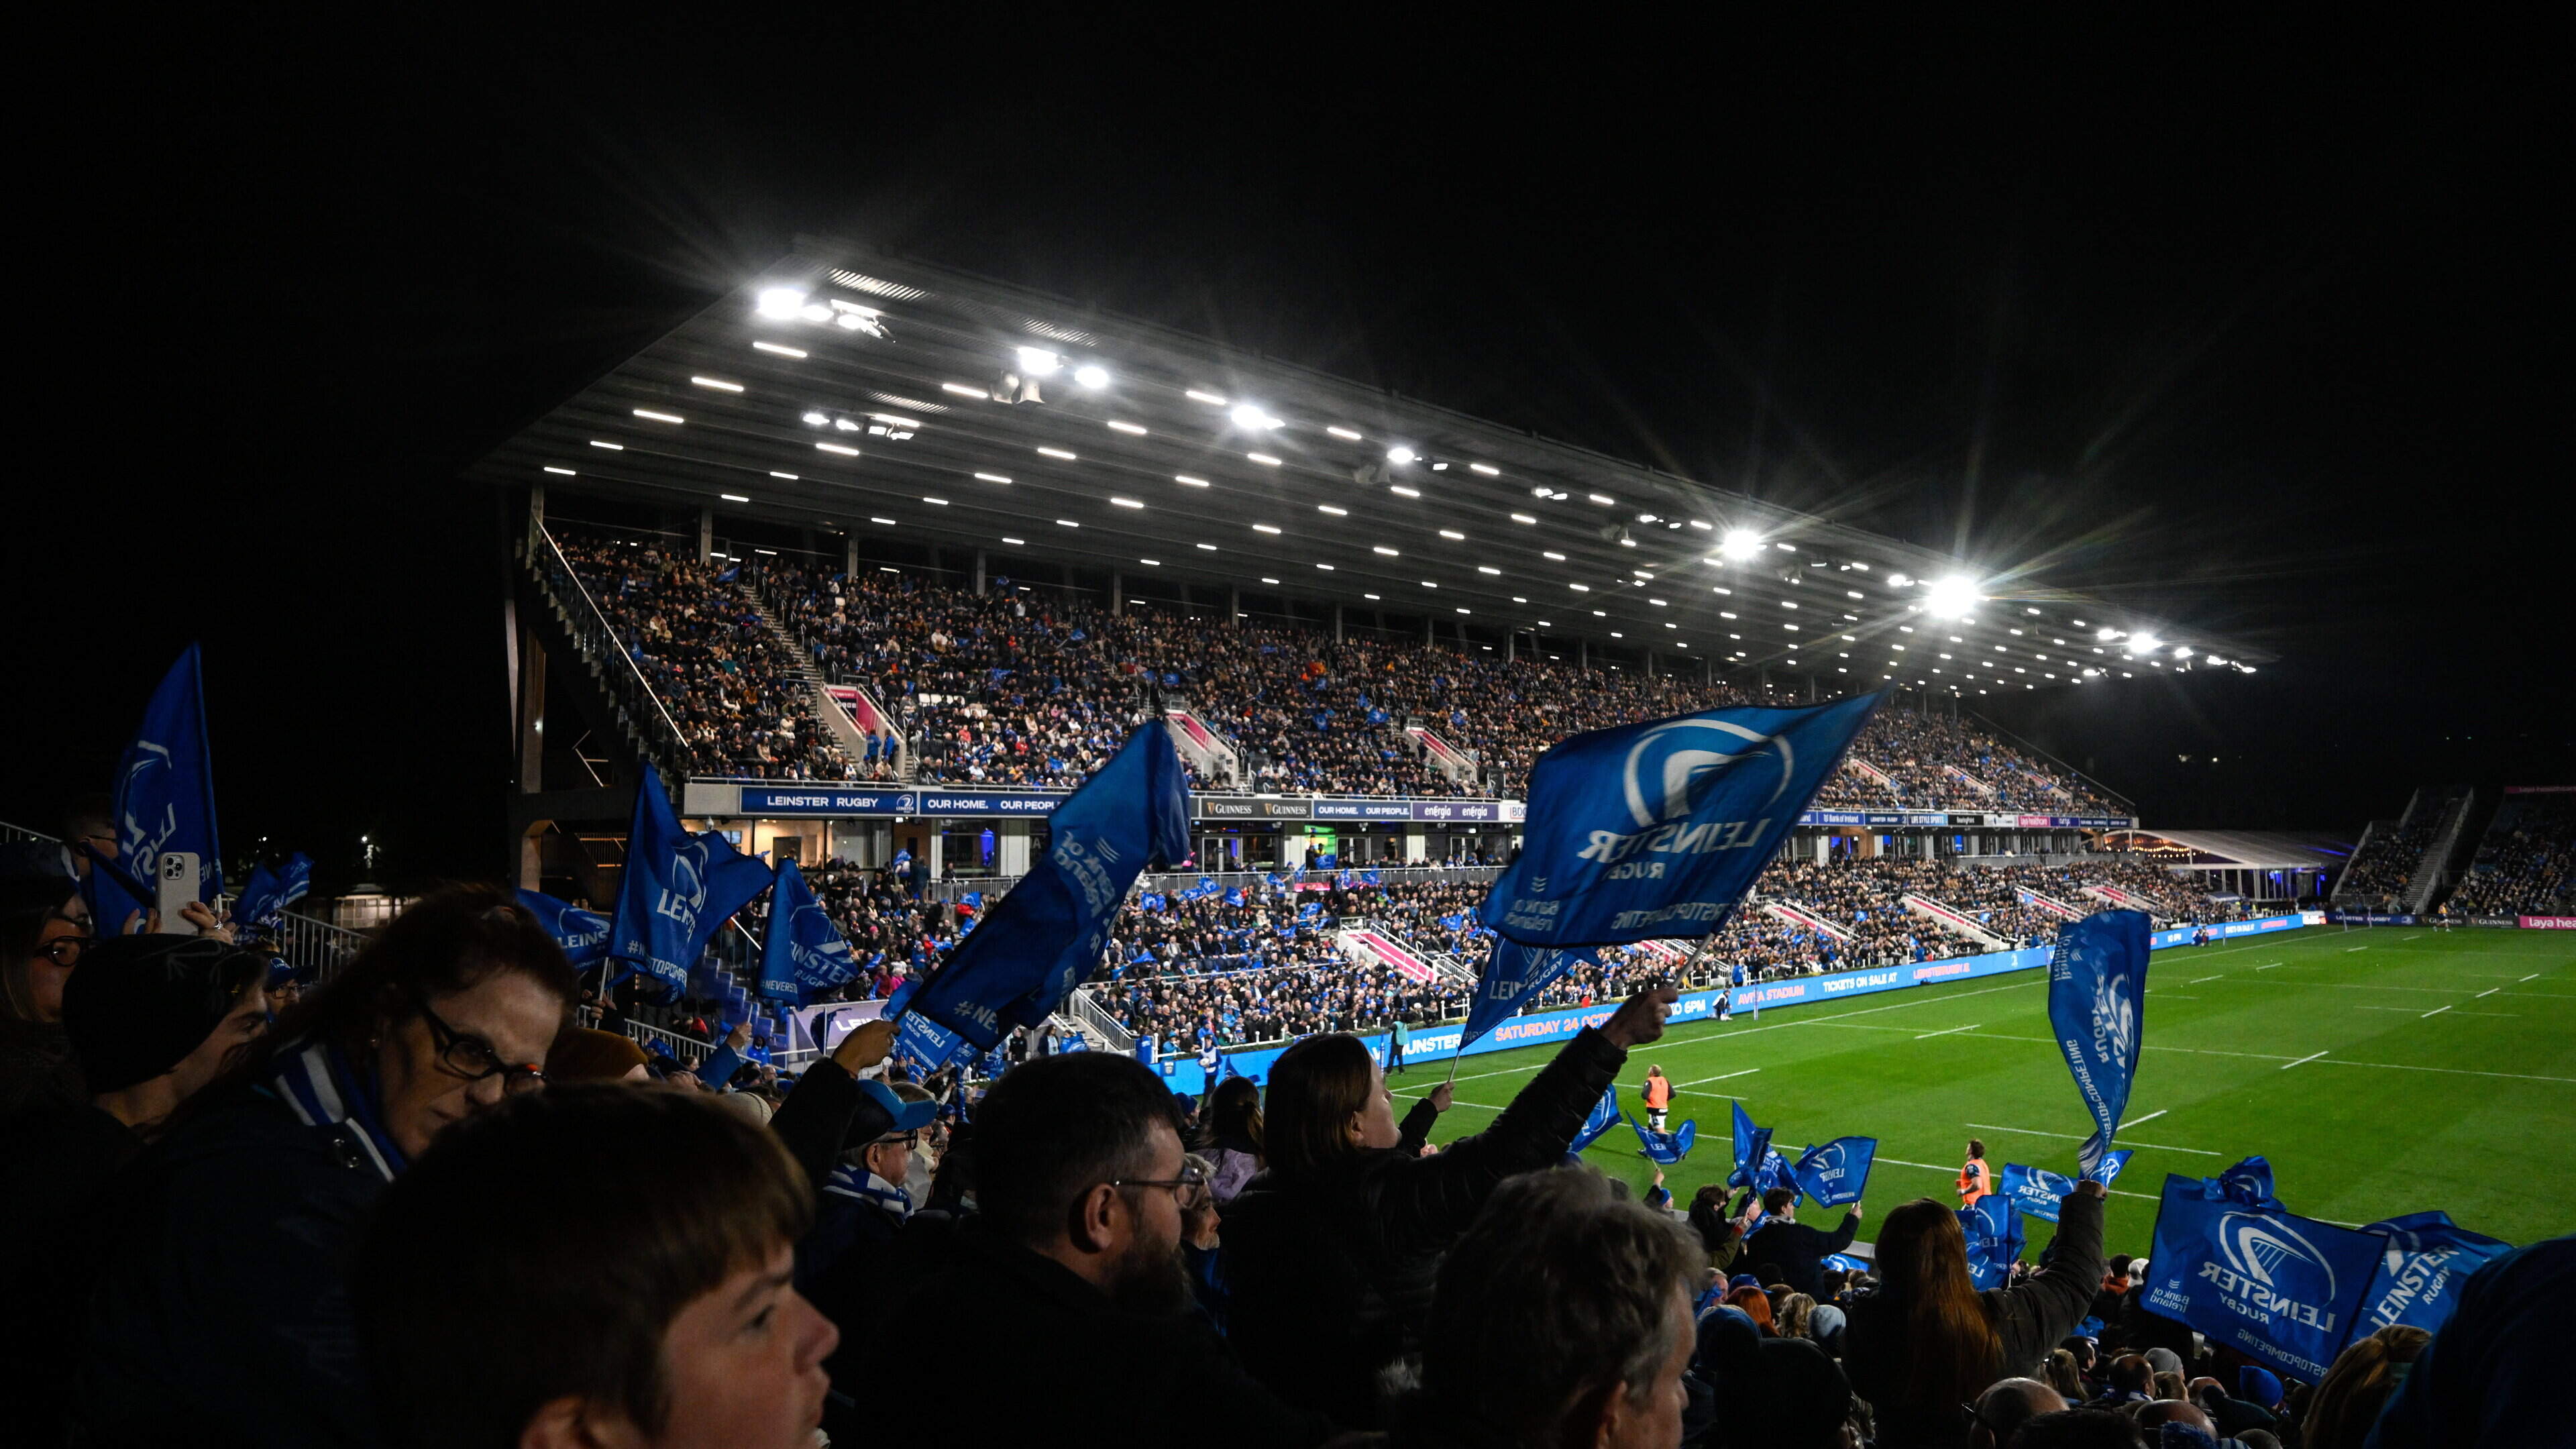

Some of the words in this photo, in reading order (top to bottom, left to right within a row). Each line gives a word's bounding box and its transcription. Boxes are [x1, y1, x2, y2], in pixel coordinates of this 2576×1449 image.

[767, 796, 829, 807] LEINSTER
[837, 797, 879, 808] RUGBY
[927, 799, 953, 809] OUR
[953, 800, 989, 809] HOME.
[1000, 800, 1022, 810] OUR
[1215, 804, 1252, 814] GUINNESS
[1272, 804, 1307, 815] GUINNESS
[1318, 806, 1334, 814] OUR
[1335, 806, 1358, 814] HOME.
[1366, 807, 1381, 815] OUR
[1381, 808, 1409, 816] PEOPLE.
[2478, 918, 2514, 926] GUINNESS
[2528, 917, 2554, 929] laya
[1527, 957, 1564, 991] RUGBY
[1766, 985, 1805, 1000] STADIUM
[1823, 978, 1855, 993] TICKETS
[1856, 977, 1868, 988] ON
[1868, 974, 1888, 986] SALE
[1888, 972, 1898, 983] AT
[1495, 1020, 1560, 1042] SATURDAY
[1563, 1017, 1579, 1032] 24
[1684, 999, 1706, 1014] 6PM
